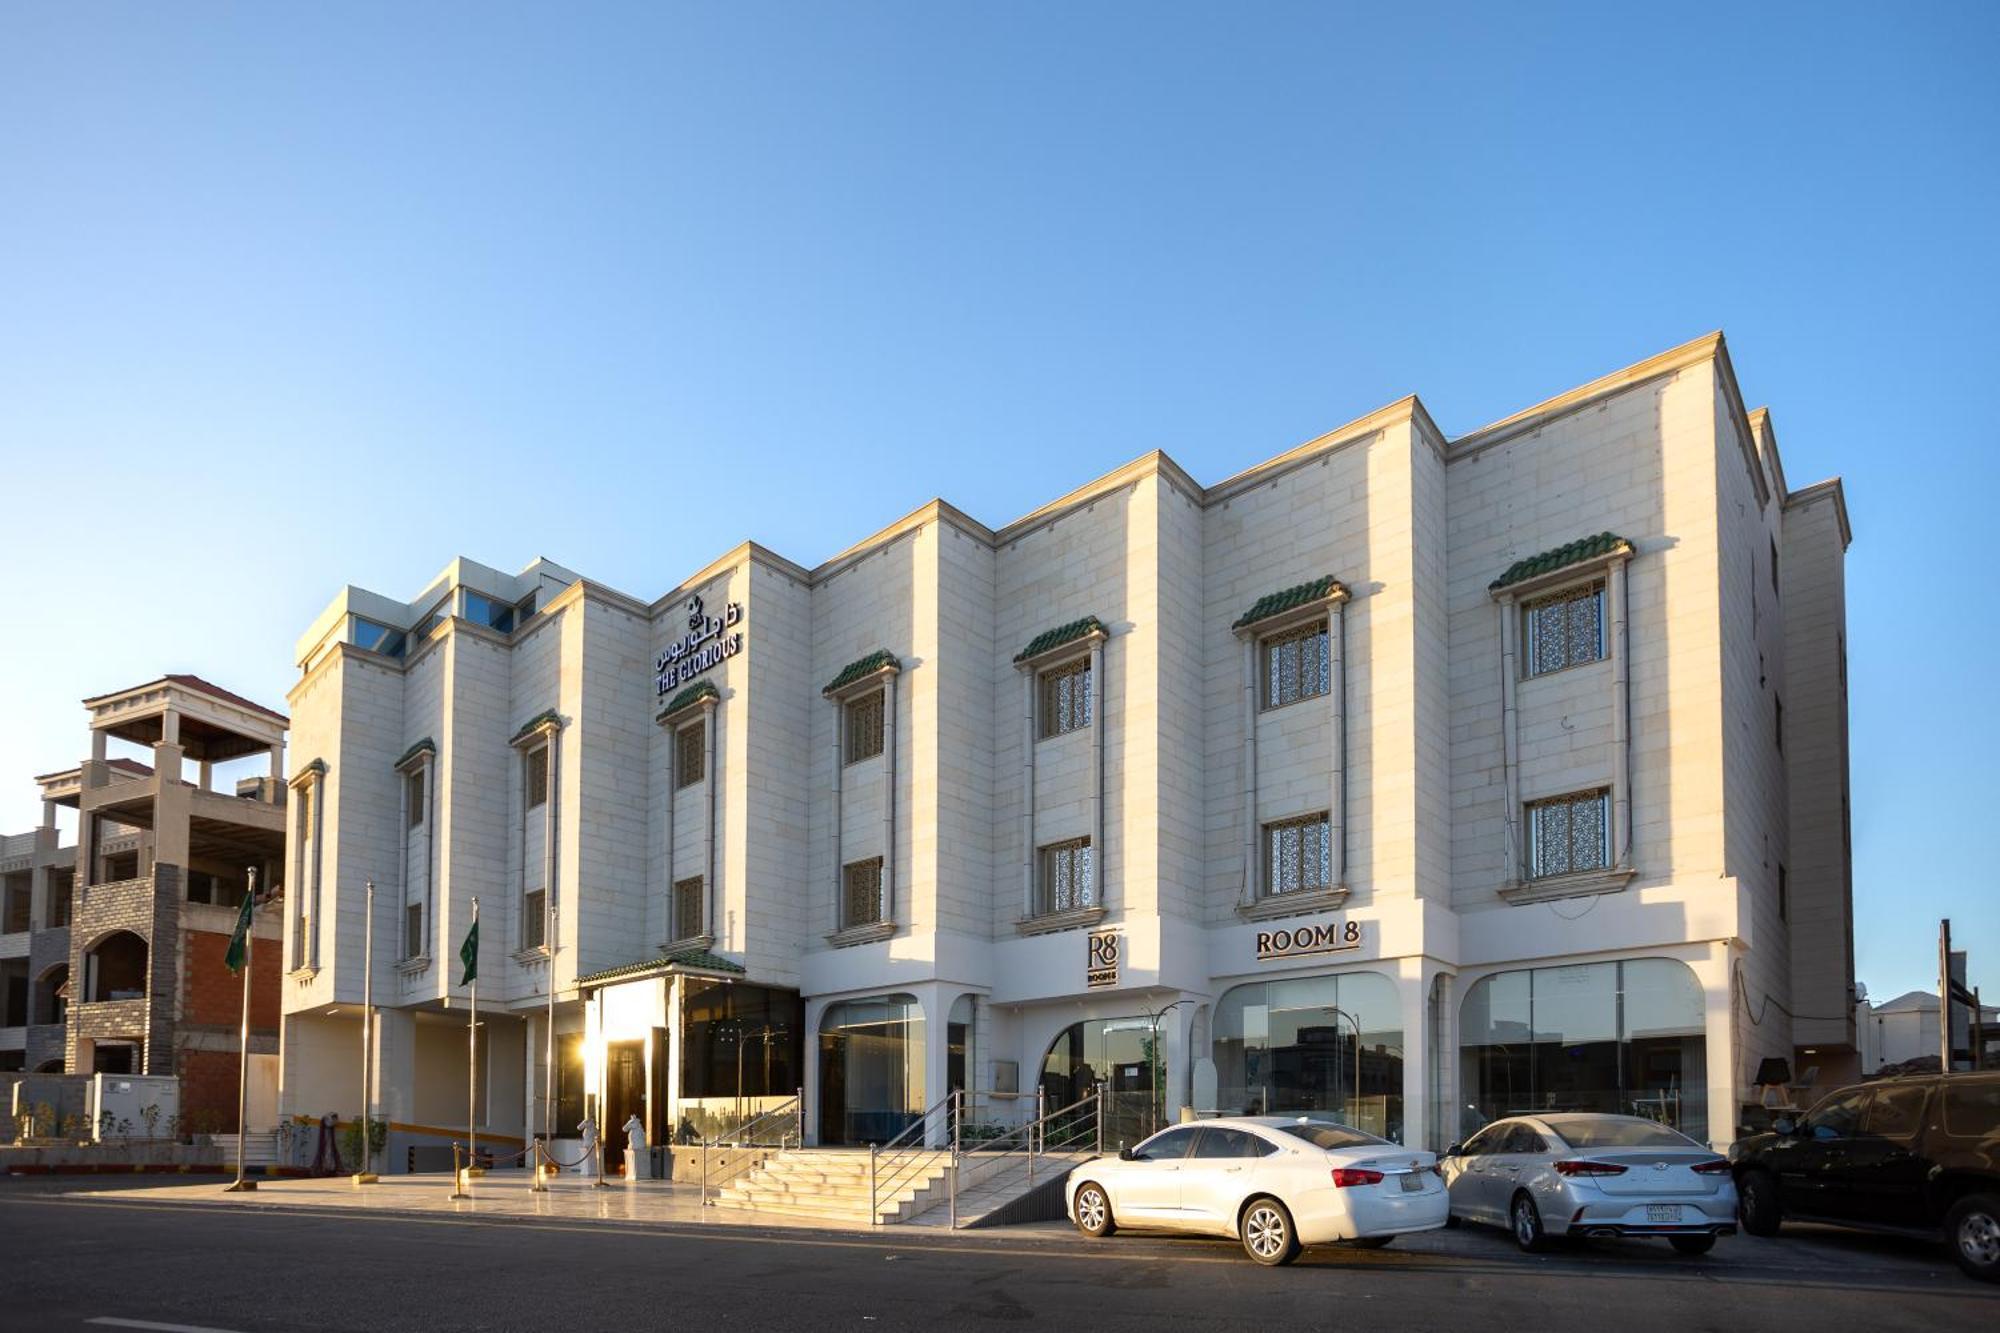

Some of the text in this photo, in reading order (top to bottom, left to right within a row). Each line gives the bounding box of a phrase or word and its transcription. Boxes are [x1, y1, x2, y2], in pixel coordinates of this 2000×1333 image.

[656, 633, 738, 694] THE GLORIOUS
[1088, 934, 1117, 968] R8
[1257, 921, 1359, 952] ROOM 8
